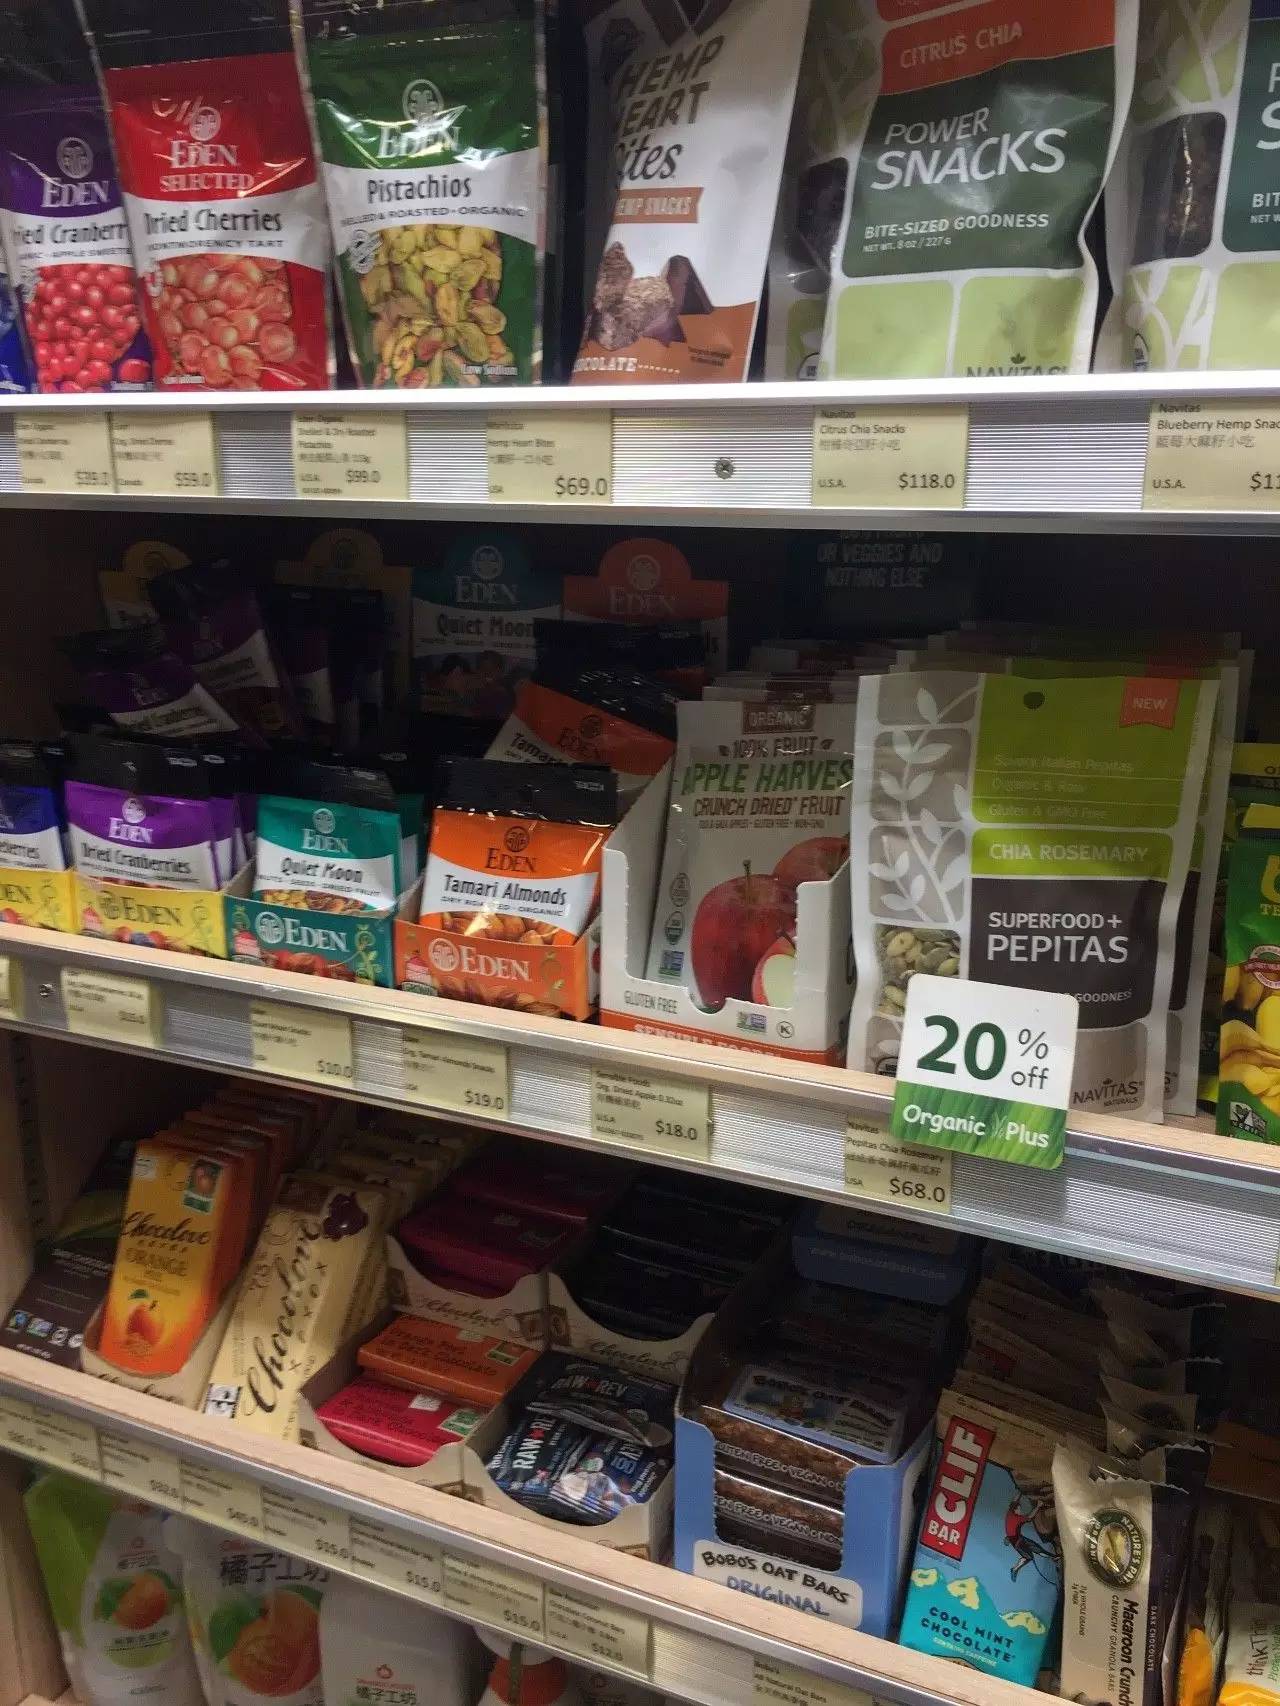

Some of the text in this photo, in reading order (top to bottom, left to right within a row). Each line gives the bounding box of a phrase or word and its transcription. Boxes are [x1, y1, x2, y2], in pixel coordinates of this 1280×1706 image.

[900, 22, 1023, 70] CITRUS CHIA
[618, 35, 724, 96] HEMP
[885, 107, 990, 146] POWER
[169, 140, 238, 169] EDEN
[870, 127, 1068, 191] SNACKS
[41, 178, 111, 208] EDEN
[159, 173, 254, 192] SELECTED
[366, 174, 472, 205] Pistachios
[195, 208, 283, 234] Cherries
[388, 206, 449, 219] ROASTED
[458, 205, 526, 217] ORGANIC
[864, 213, 1049, 240] BITE-SIZED GOODNESS
[1159, 403, 1202, 413] Navitas
[820, 424, 906, 434] Citrus Chia Snacks
[1157, 419, 1214, 432] Blueberry
[1216, 420, 1252, 431] Hemp
[555, 475, 608, 497] $69.0
[899, 473, 956, 491] $118.0
[1152, 479, 1186, 490] U.S.A.
[436, 614, 482, 637] Quiet
[1131, 697, 1168, 713] NEW
[773, 735, 819, 755] FRUIT
[694, 795, 846, 818] CRUNCH DRIED FRUIT
[107, 817, 154, 844] EDEN
[301, 828, 349, 853] EDEN
[486, 848, 537, 873] EDEN
[989, 842, 1149, 863] CHIA ROSEMARY
[281, 857, 363, 884] Quiet Moon
[443, 874, 567, 907] Tamari Almonds
[121, 895, 185, 926] EDEN
[988, 911, 1123, 930] SUPERFOOD+
[283, 917, 350, 952] EDEN
[459, 943, 532, 982] EDEN
[986, 935, 1129, 964] PEPITAS
[624, 988, 679, 1015] GLUTEN FREE
[915, 1014, 1050, 1081] 20 %
[1010, 1065, 1051, 1091] off
[464, 1087, 504, 1110] $19.0
[1072, 1080, 1139, 1105] NAVITAS
[655, 1119, 698, 1141] $18.0
[902, 1103, 1051, 1150] Organic Plus
[901, 1146, 945, 1163] Rosemary
[889, 1176, 946, 1203] $68.0
[511, 1438, 544, 1470] RAW
[934, 1426, 985, 1525] CLIF
[926, 1519, 961, 1546] BAR
[761, 1560, 798, 1583] OAT
[801, 1574, 850, 1604] BARS
[725, 1576, 831, 1617] ORIGINAL
[1110, 1594, 1120, 1633] CRUNCHY
[920, 1617, 1013, 1664] CHOCOLATE
[929, 1605, 1015, 1650] COOL MINT
[1109, 1634, 1118, 1672] GRANOLA
[1118, 1599, 1139, 1706] Macaroon Crunch
[1147, 1627, 1157, 1672] CHOCOLATE
